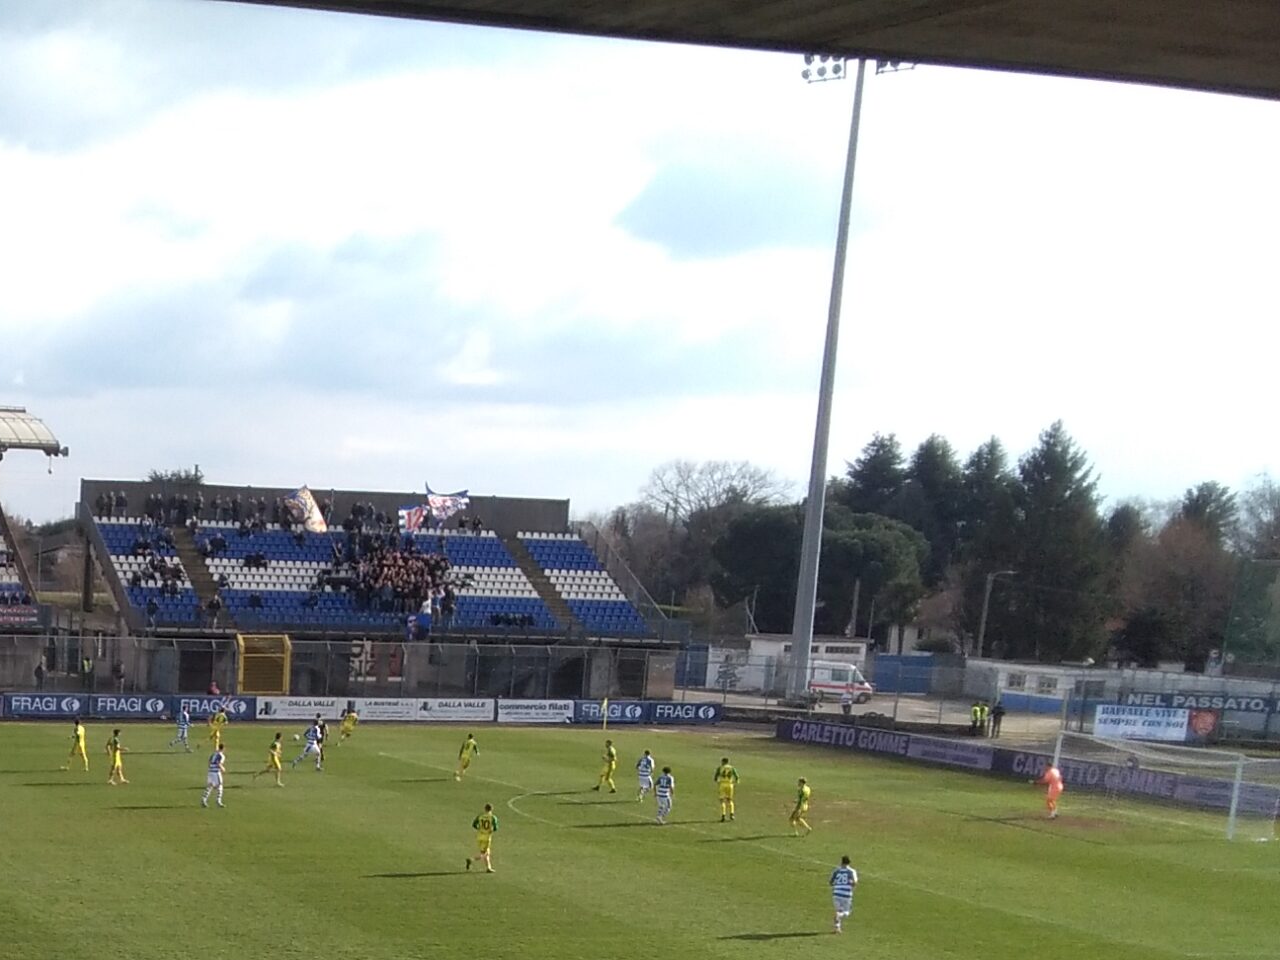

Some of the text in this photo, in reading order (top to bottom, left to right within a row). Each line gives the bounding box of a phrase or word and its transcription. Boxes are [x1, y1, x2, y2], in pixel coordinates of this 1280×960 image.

[11, 697, 57, 711] FRAGI
[97, 698, 142, 712] FRAGI
[498, 702, 570, 711] commercio filati
[1127, 693, 1167, 706] NEL
[581, 704, 622, 718] FRAGI
[655, 705, 696, 719] FRAGI
[1097, 717, 1137, 727] SEMPRE
[1141, 719, 1161, 728] CON
[791, 721, 856, 747] CARLETTO
[858, 730, 909, 755] GOMME
[1012, 754, 1177, 796] CARTTO GOMME
[480, 819, 490, 830] 10
[836, 873, 848, 885] 28
